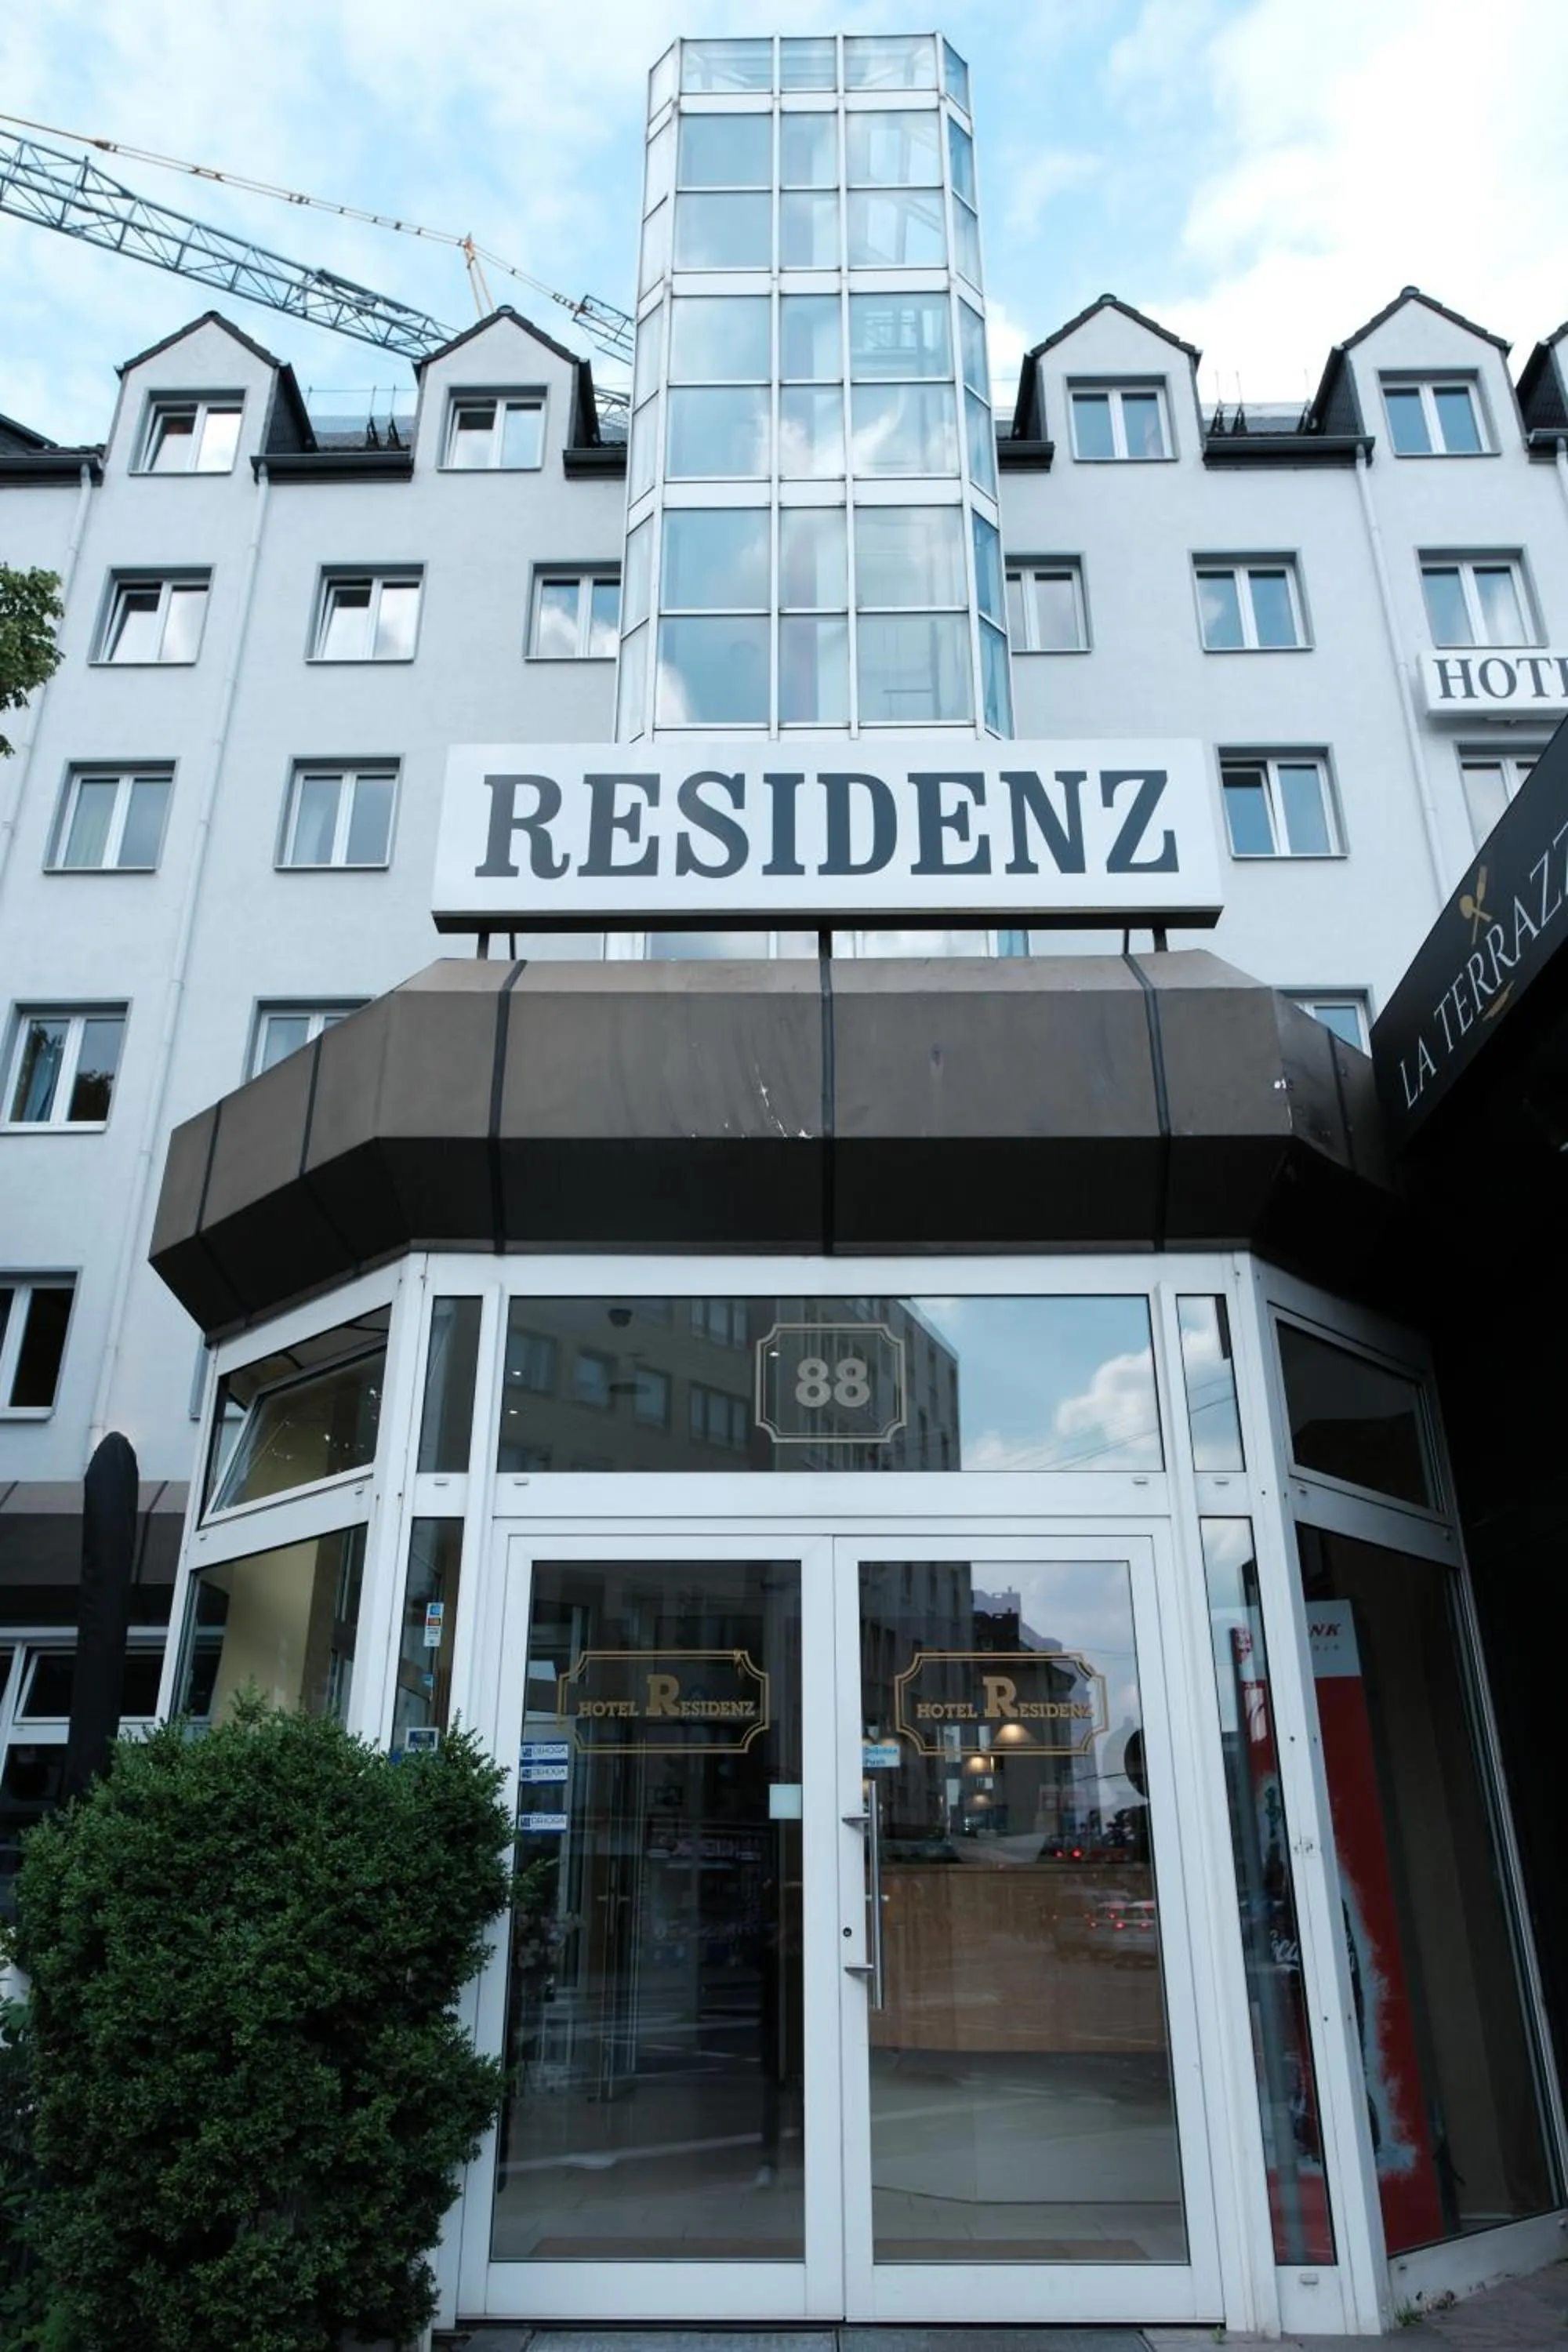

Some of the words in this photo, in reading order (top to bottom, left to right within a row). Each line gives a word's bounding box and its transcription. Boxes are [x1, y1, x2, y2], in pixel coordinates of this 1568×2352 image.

[474, 769, 1180, 880] RESIDENZ
[1399, 1036, 1438, 1109] LA
[795, 1357, 870, 1408] 88
[578, 1700, 639, 1717] HOTEL
[645, 1673, 756, 1717] RESIDENZ
[916, 1702, 978, 1719] HOTEL
